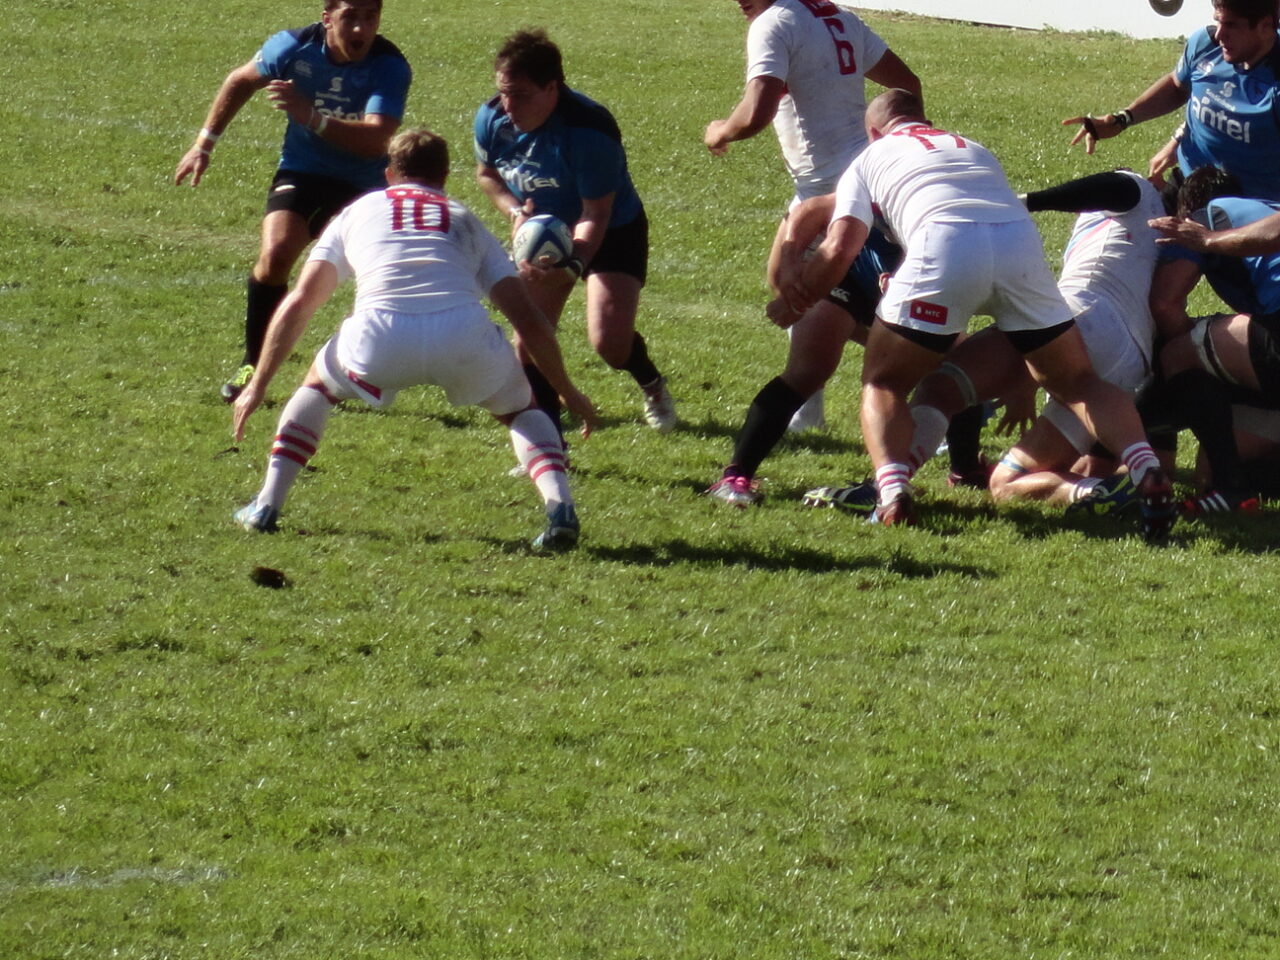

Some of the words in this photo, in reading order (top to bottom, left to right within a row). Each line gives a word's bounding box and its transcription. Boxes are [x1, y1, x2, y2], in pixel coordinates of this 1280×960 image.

[822, 17, 857, 75] 6
[1191, 95, 1251, 144] antel
[390, 198, 450, 234] 10
